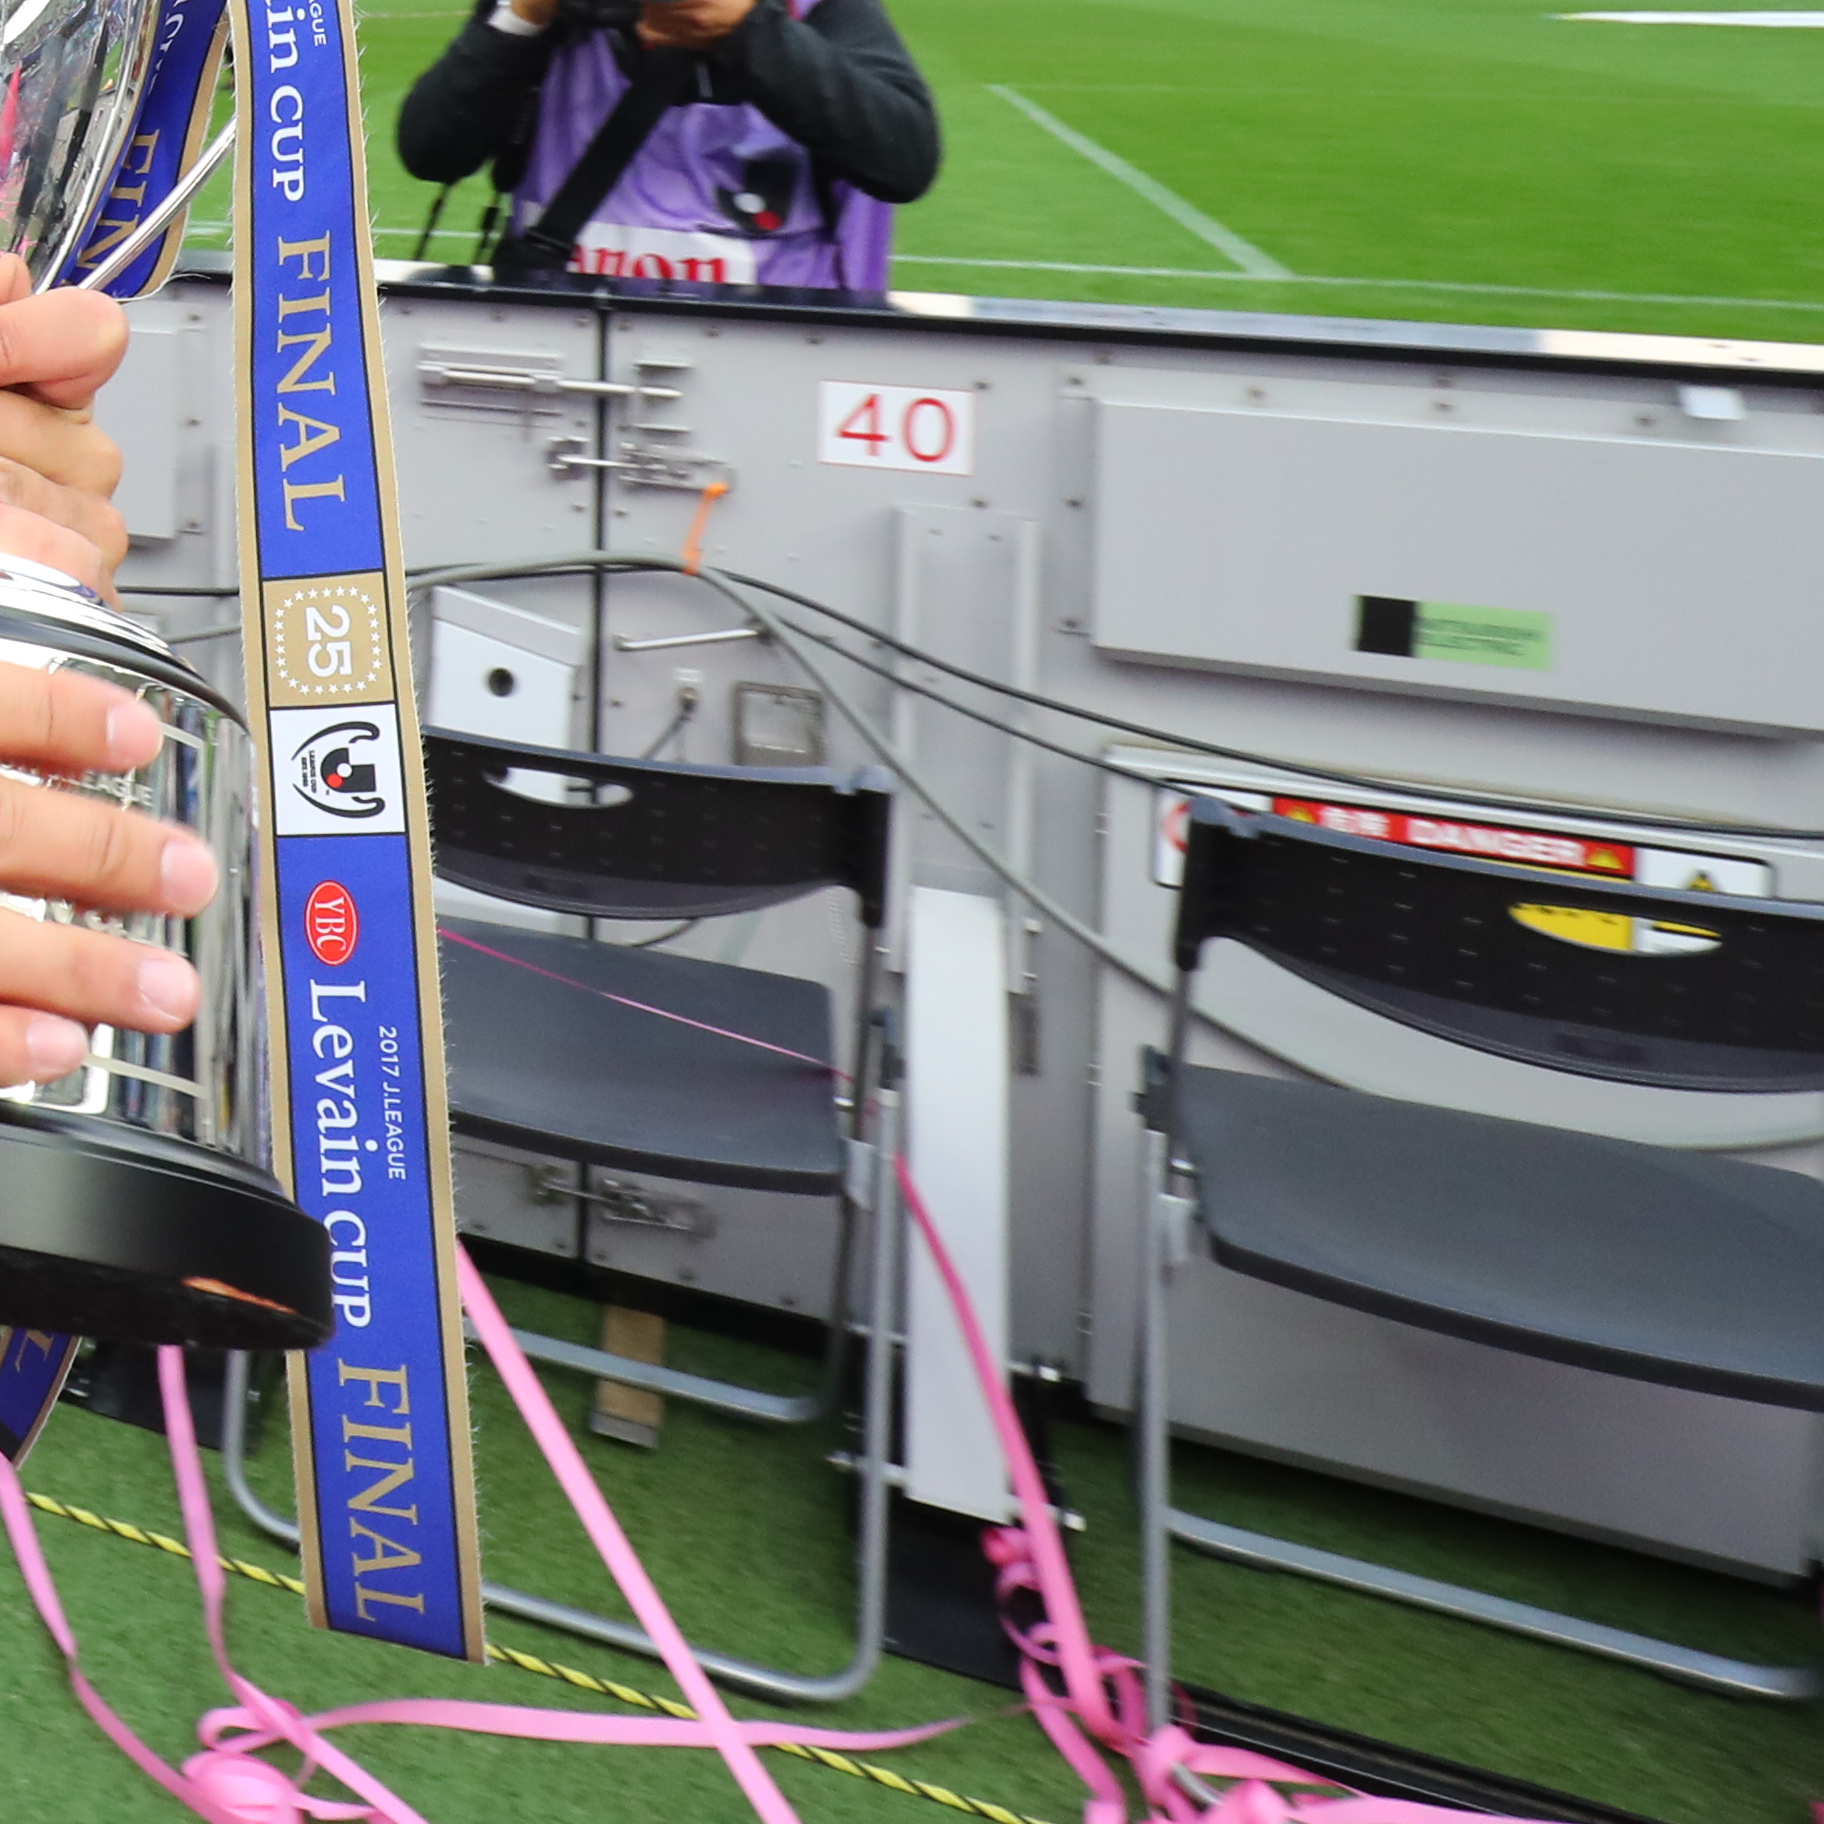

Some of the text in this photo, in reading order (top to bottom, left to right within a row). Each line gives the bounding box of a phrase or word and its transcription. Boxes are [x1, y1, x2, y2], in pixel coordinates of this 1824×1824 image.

[269, 85, 305, 202] CUP
[276, 230, 345, 531] FINAL
[837, 393, 958, 463] 40
[304, 605, 352, 678] 25
[1408, 818, 1587, 867] DANGER
[379, 1026, 406, 1181] 2017 J.LEAGUE
[309, 896, 425, 1624] YBC Levain CUP FINAL
